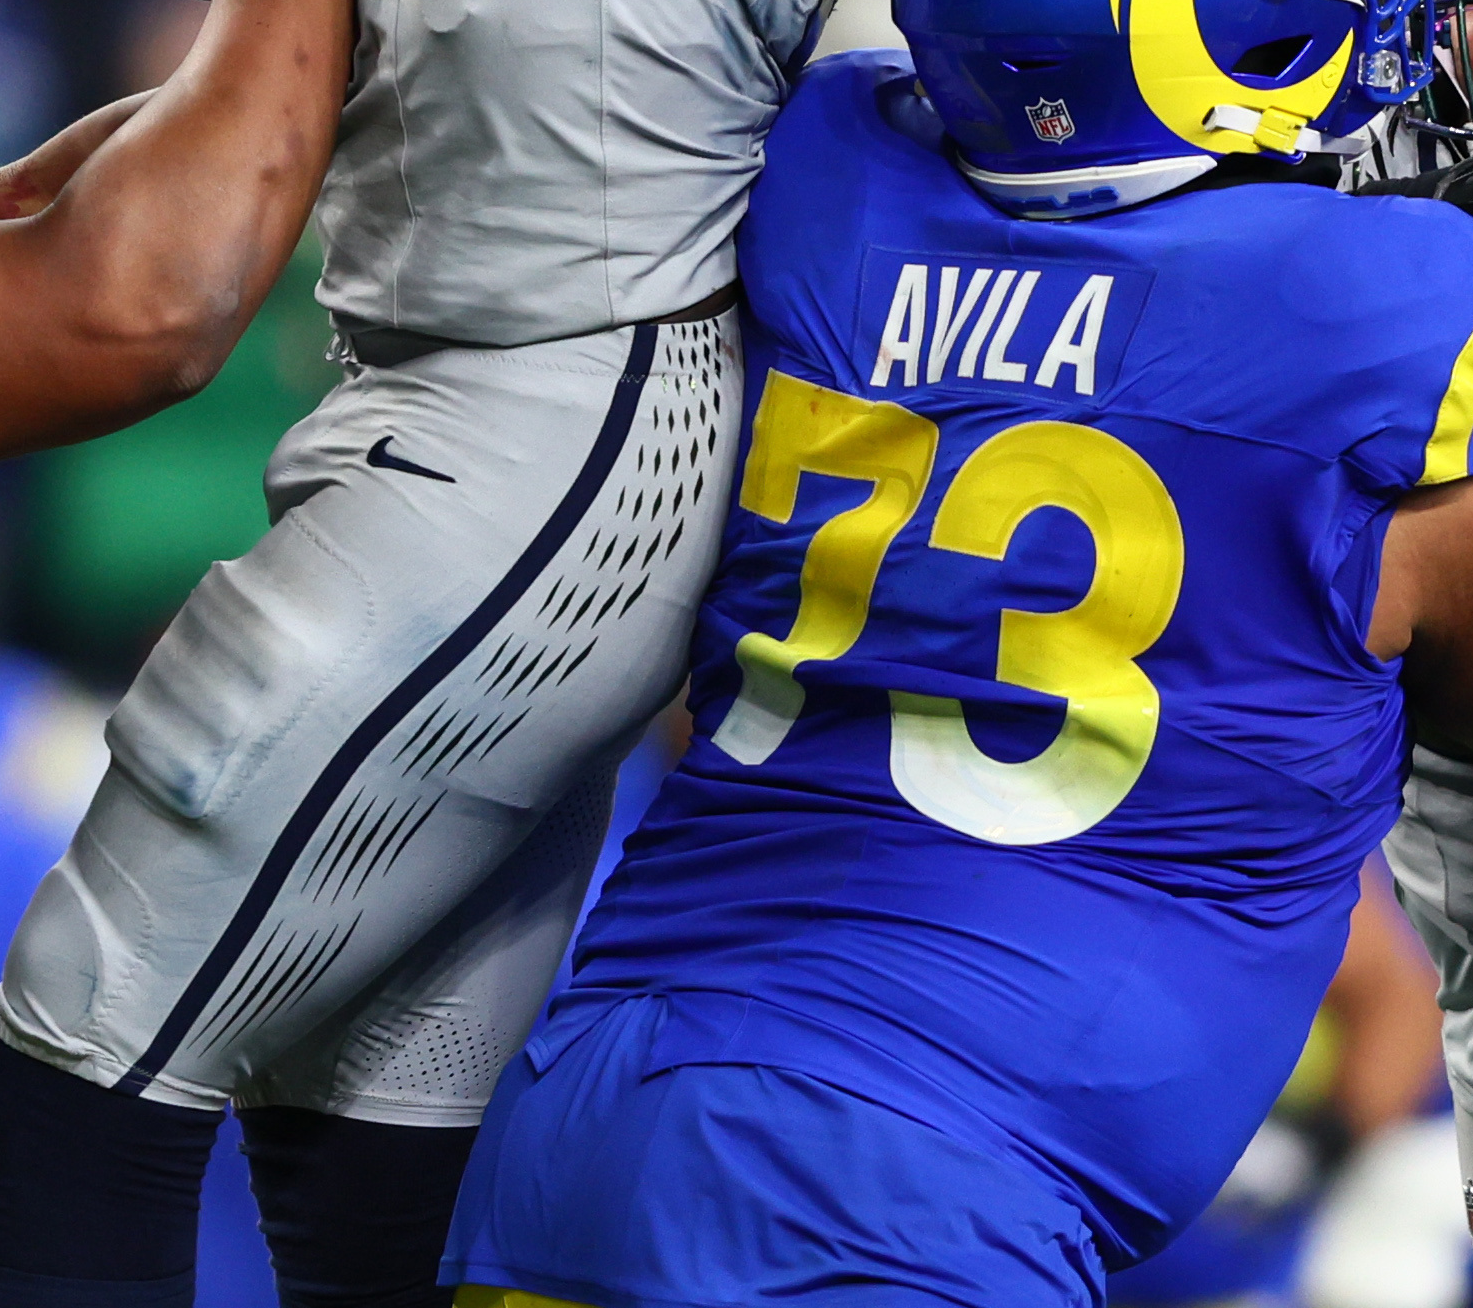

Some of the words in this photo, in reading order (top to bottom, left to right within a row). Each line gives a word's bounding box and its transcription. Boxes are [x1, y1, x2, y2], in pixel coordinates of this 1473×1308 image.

[1037, 116, 1070, 137] NFL
[870, 264, 1114, 396] AVILA
[711, 368, 1185, 845] 73
